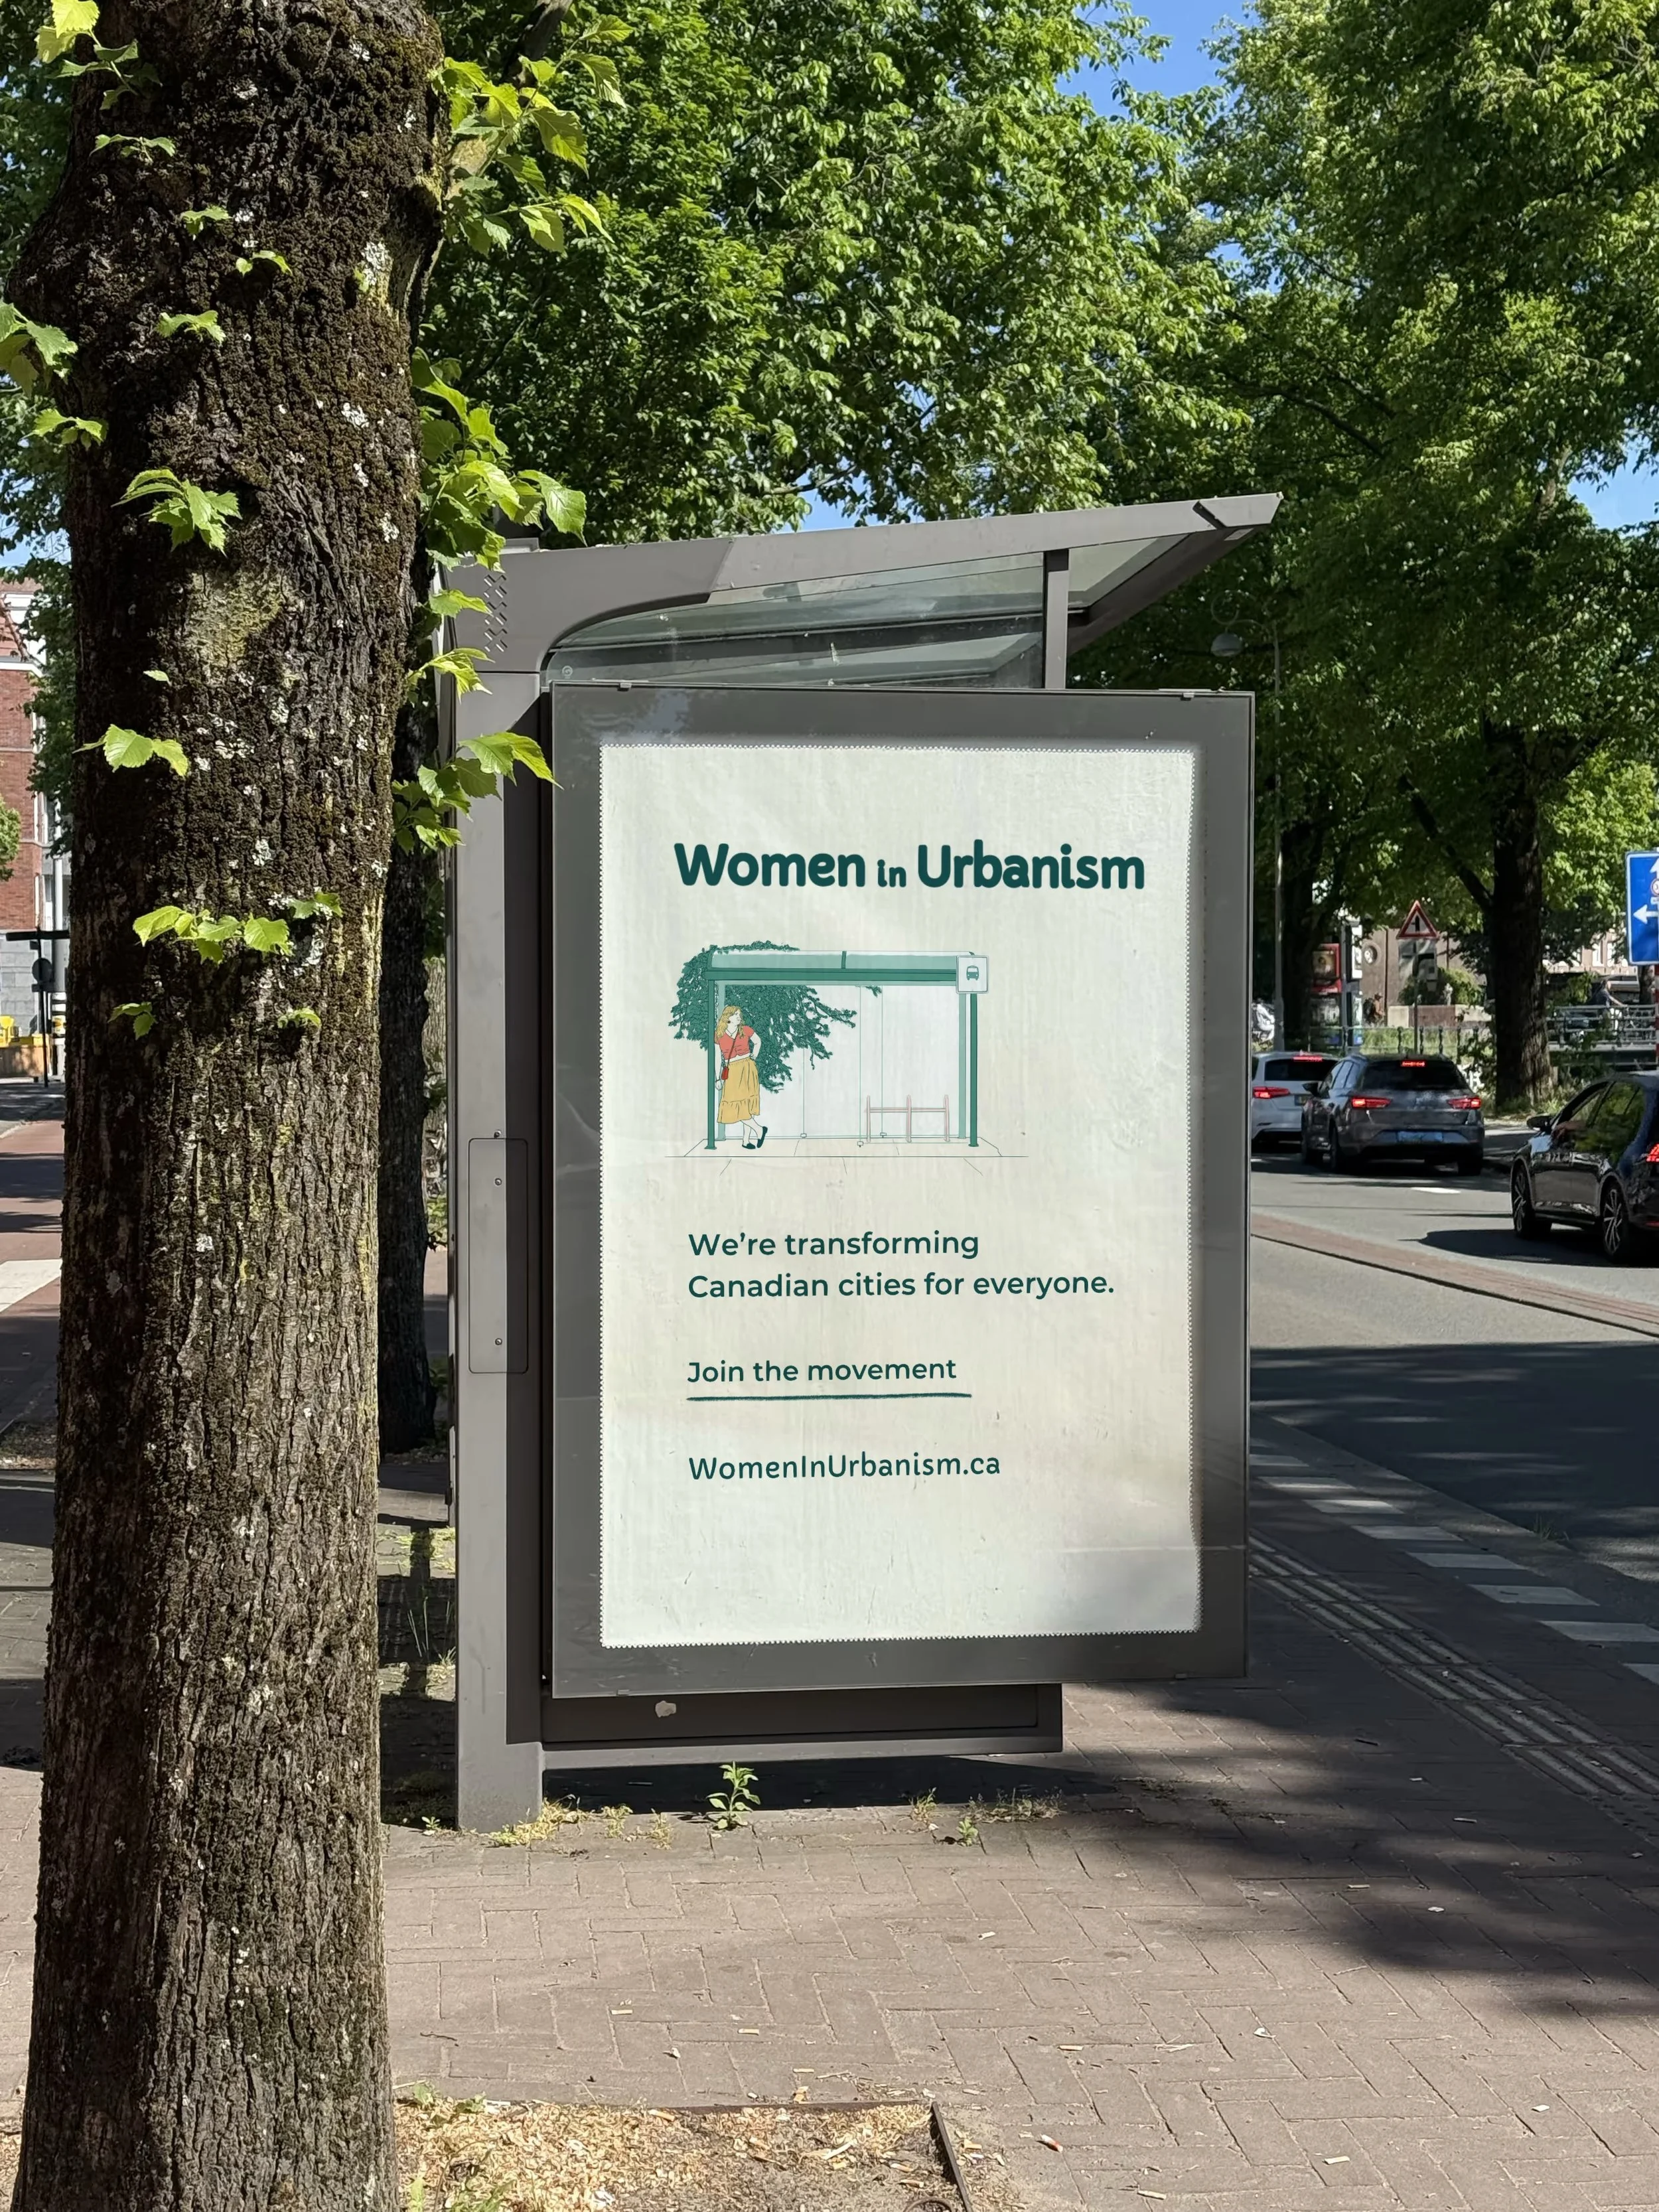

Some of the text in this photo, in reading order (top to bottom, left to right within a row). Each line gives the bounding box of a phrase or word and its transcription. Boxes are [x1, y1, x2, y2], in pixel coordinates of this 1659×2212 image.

[674, 839, 1145, 889] Women in Urbanism
[688, 1230, 979, 1259] We’re transforming
[688, 1272, 1115, 1299] Canadian cities for everyone.
[687, 1360, 957, 1383] Join the movement
[688, 1451, 1001, 1480] WomenInUrbanism.ca
